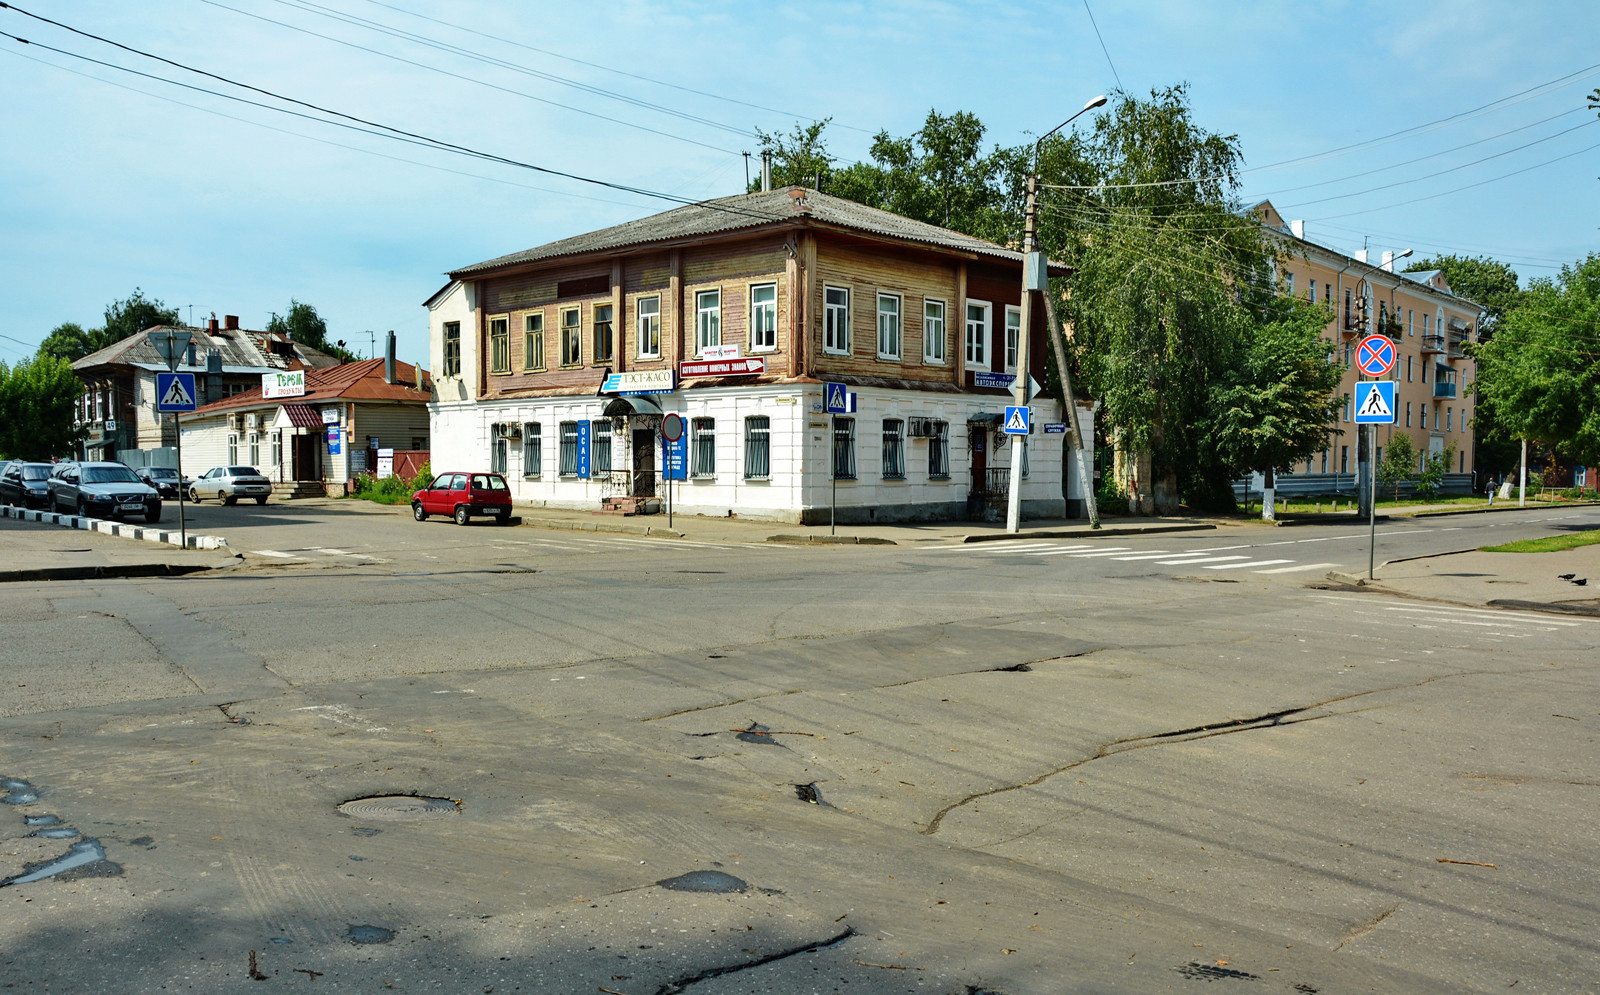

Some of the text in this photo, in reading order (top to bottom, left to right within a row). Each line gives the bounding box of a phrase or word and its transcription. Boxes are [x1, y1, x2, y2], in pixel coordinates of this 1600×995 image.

[624, 371, 671, 384] ТЭСТ-ЖАСО
[277, 387, 303, 396] ПРОДУКТЫ
[106, 421, 115, 430] 49
